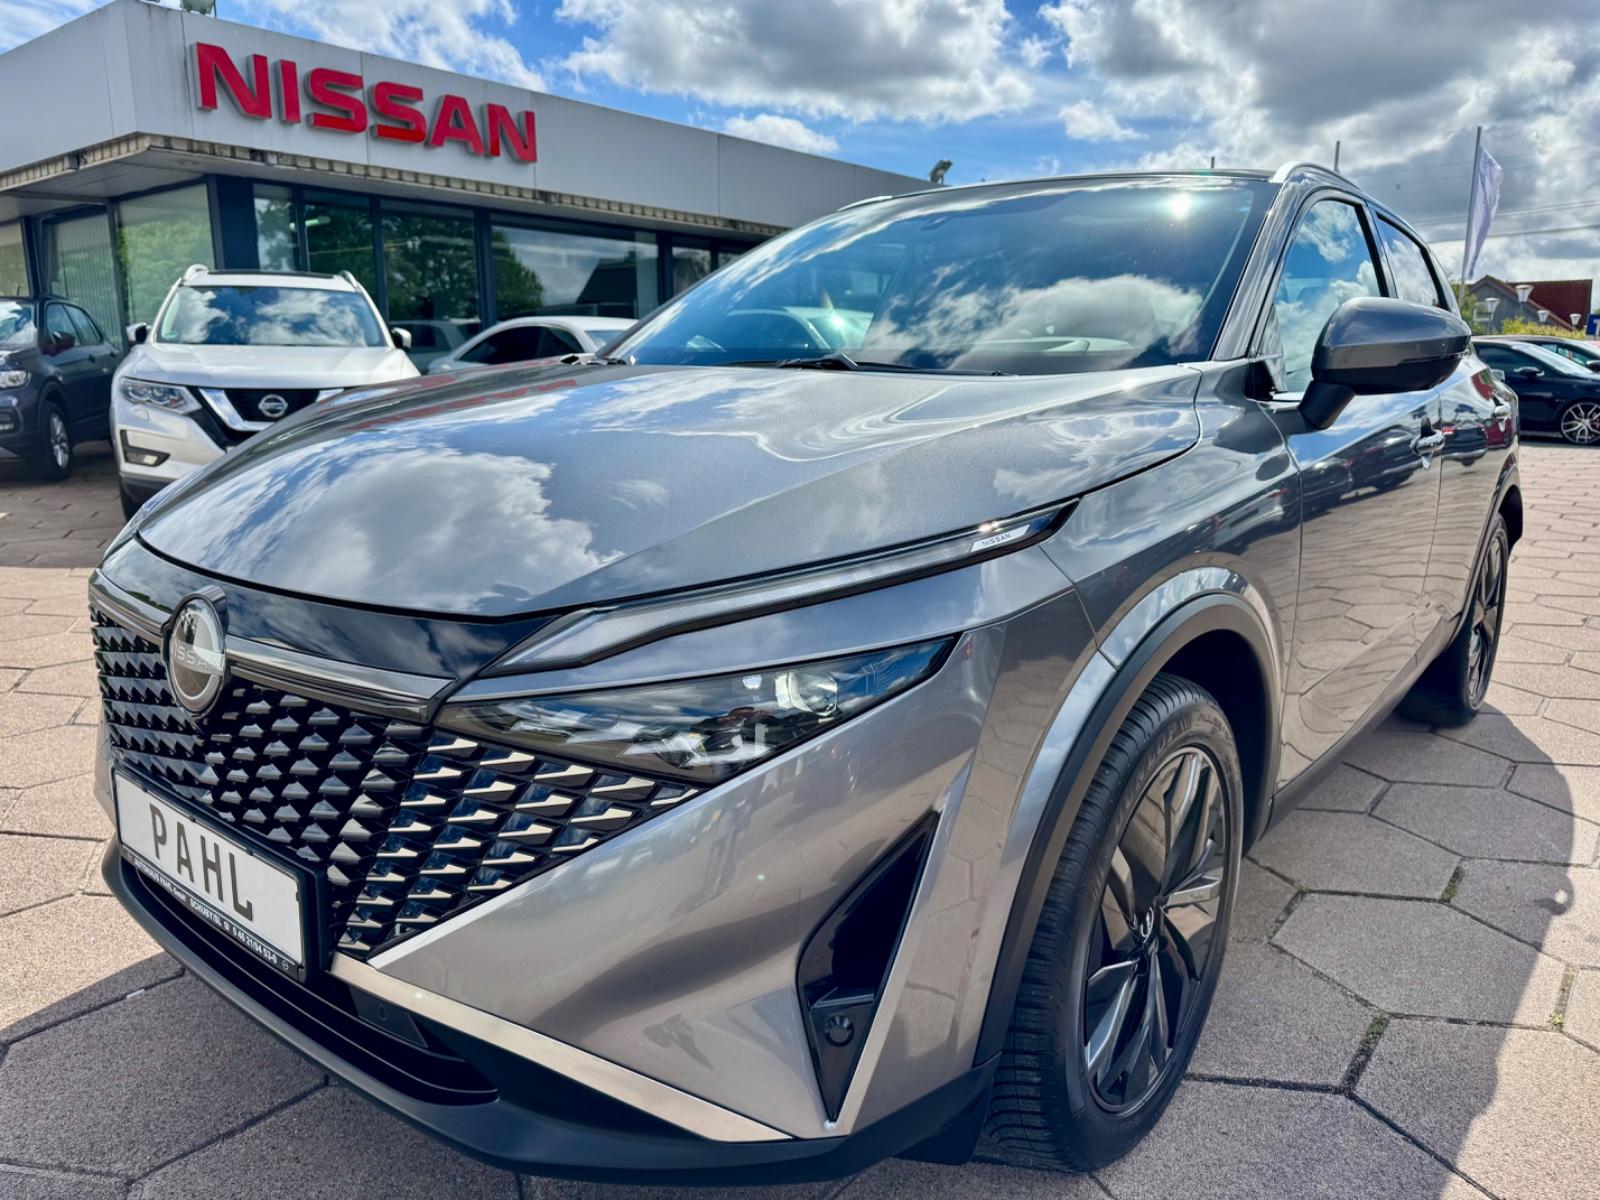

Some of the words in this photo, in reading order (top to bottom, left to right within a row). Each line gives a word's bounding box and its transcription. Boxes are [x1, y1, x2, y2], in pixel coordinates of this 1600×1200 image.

[195, 42, 537, 162] NISSAN
[982, 533, 1011, 547] NISSAN
[149, 803, 253, 921] PAHL
